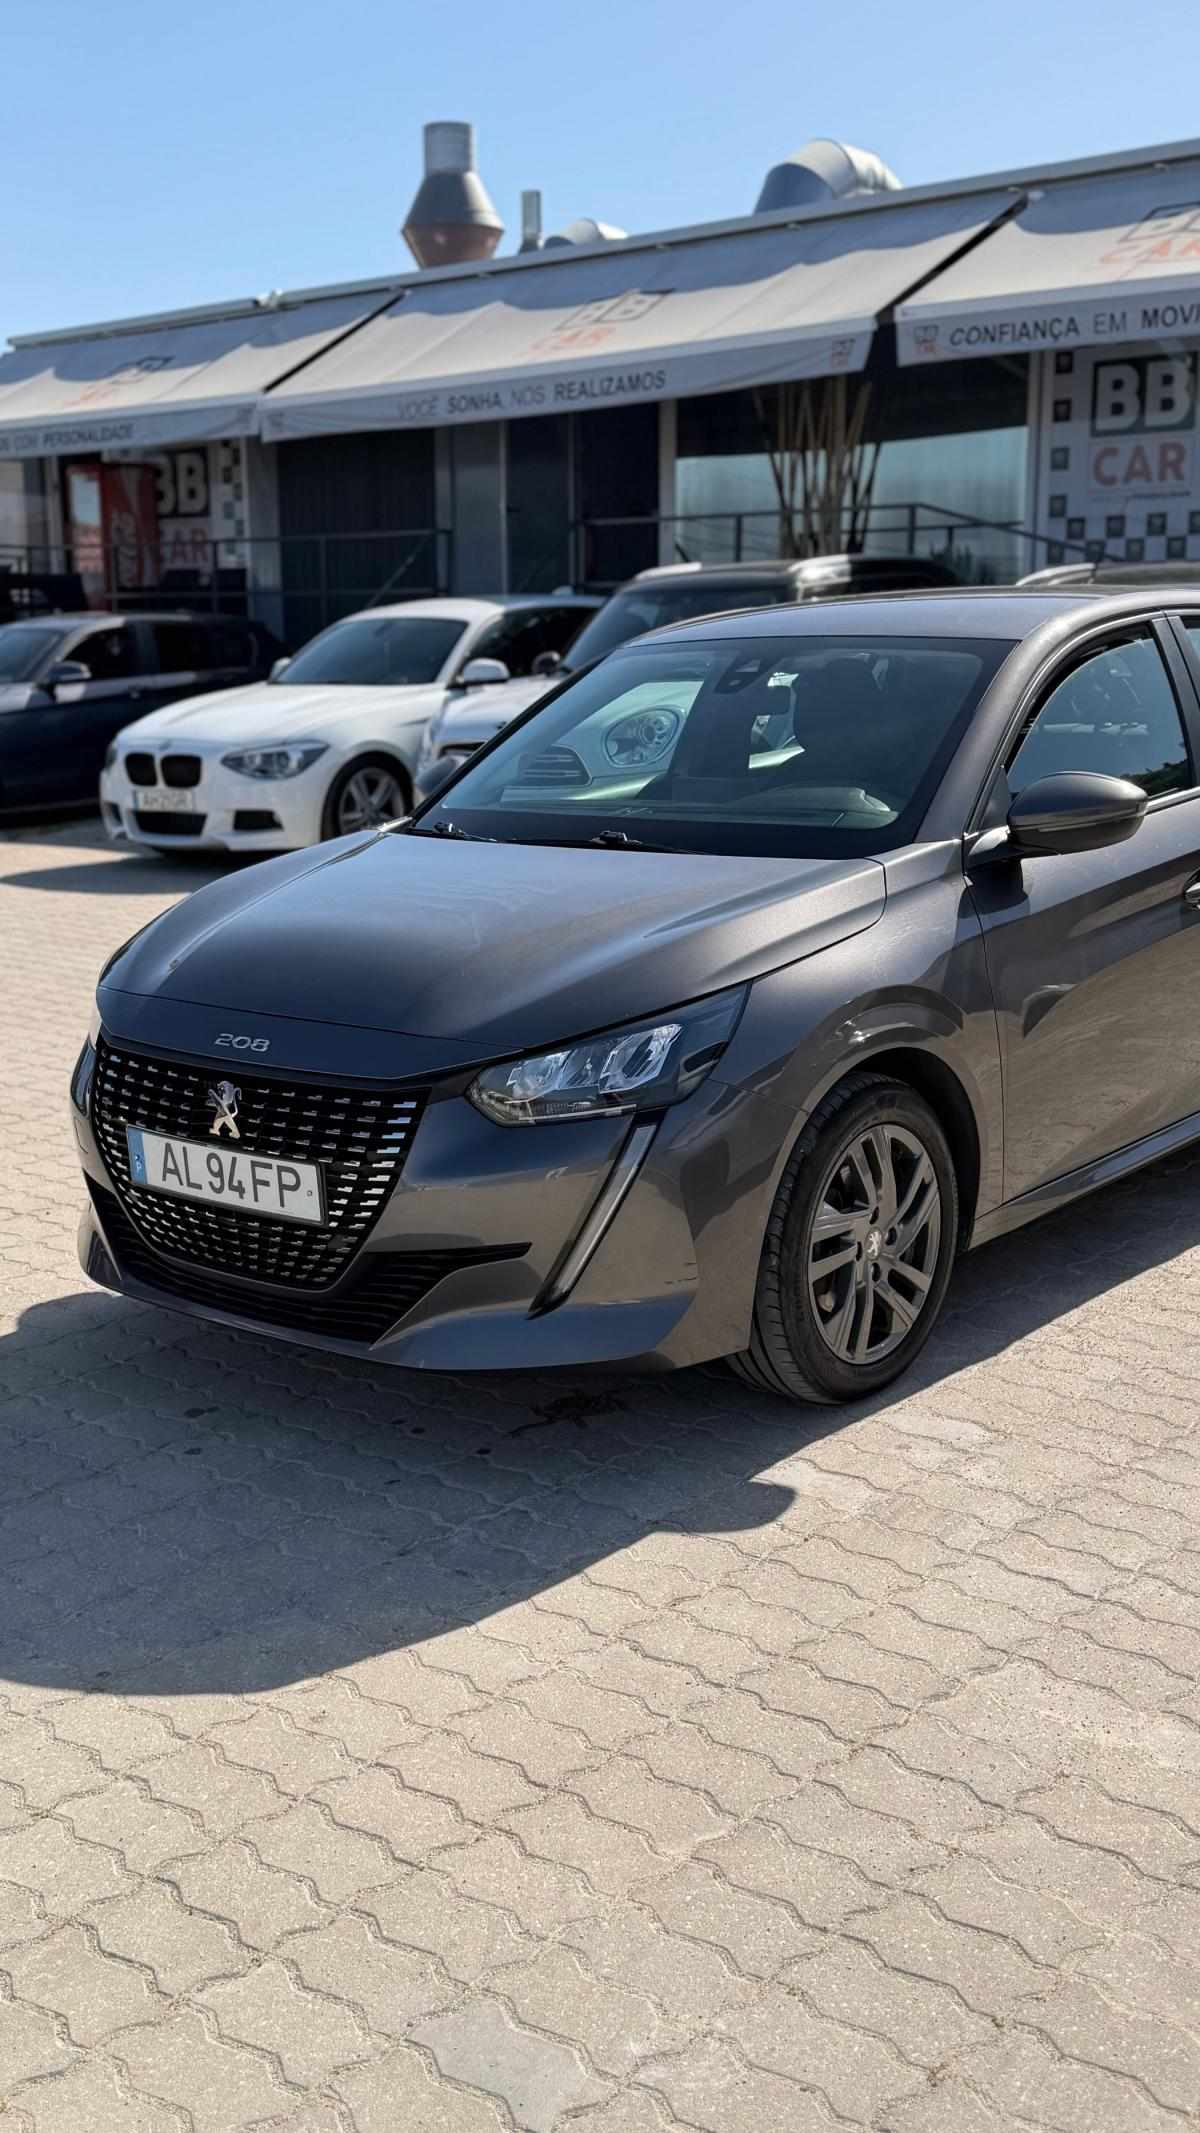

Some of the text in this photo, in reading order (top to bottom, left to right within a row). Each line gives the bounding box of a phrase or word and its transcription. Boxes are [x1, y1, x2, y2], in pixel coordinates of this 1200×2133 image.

[949, 316, 1080, 347] CONFIANÇA
[1093, 311, 1127, 335] EM
[553, 369, 667, 401] REALIZAMOS
[1095, 360, 1192, 431] BB
[43, 424, 134, 448] PERSONALIDADE
[1093, 442, 1188, 487] CAR
[214, 1033, 271, 1052] 208
[161, 1142, 301, 1208] AL94FP
